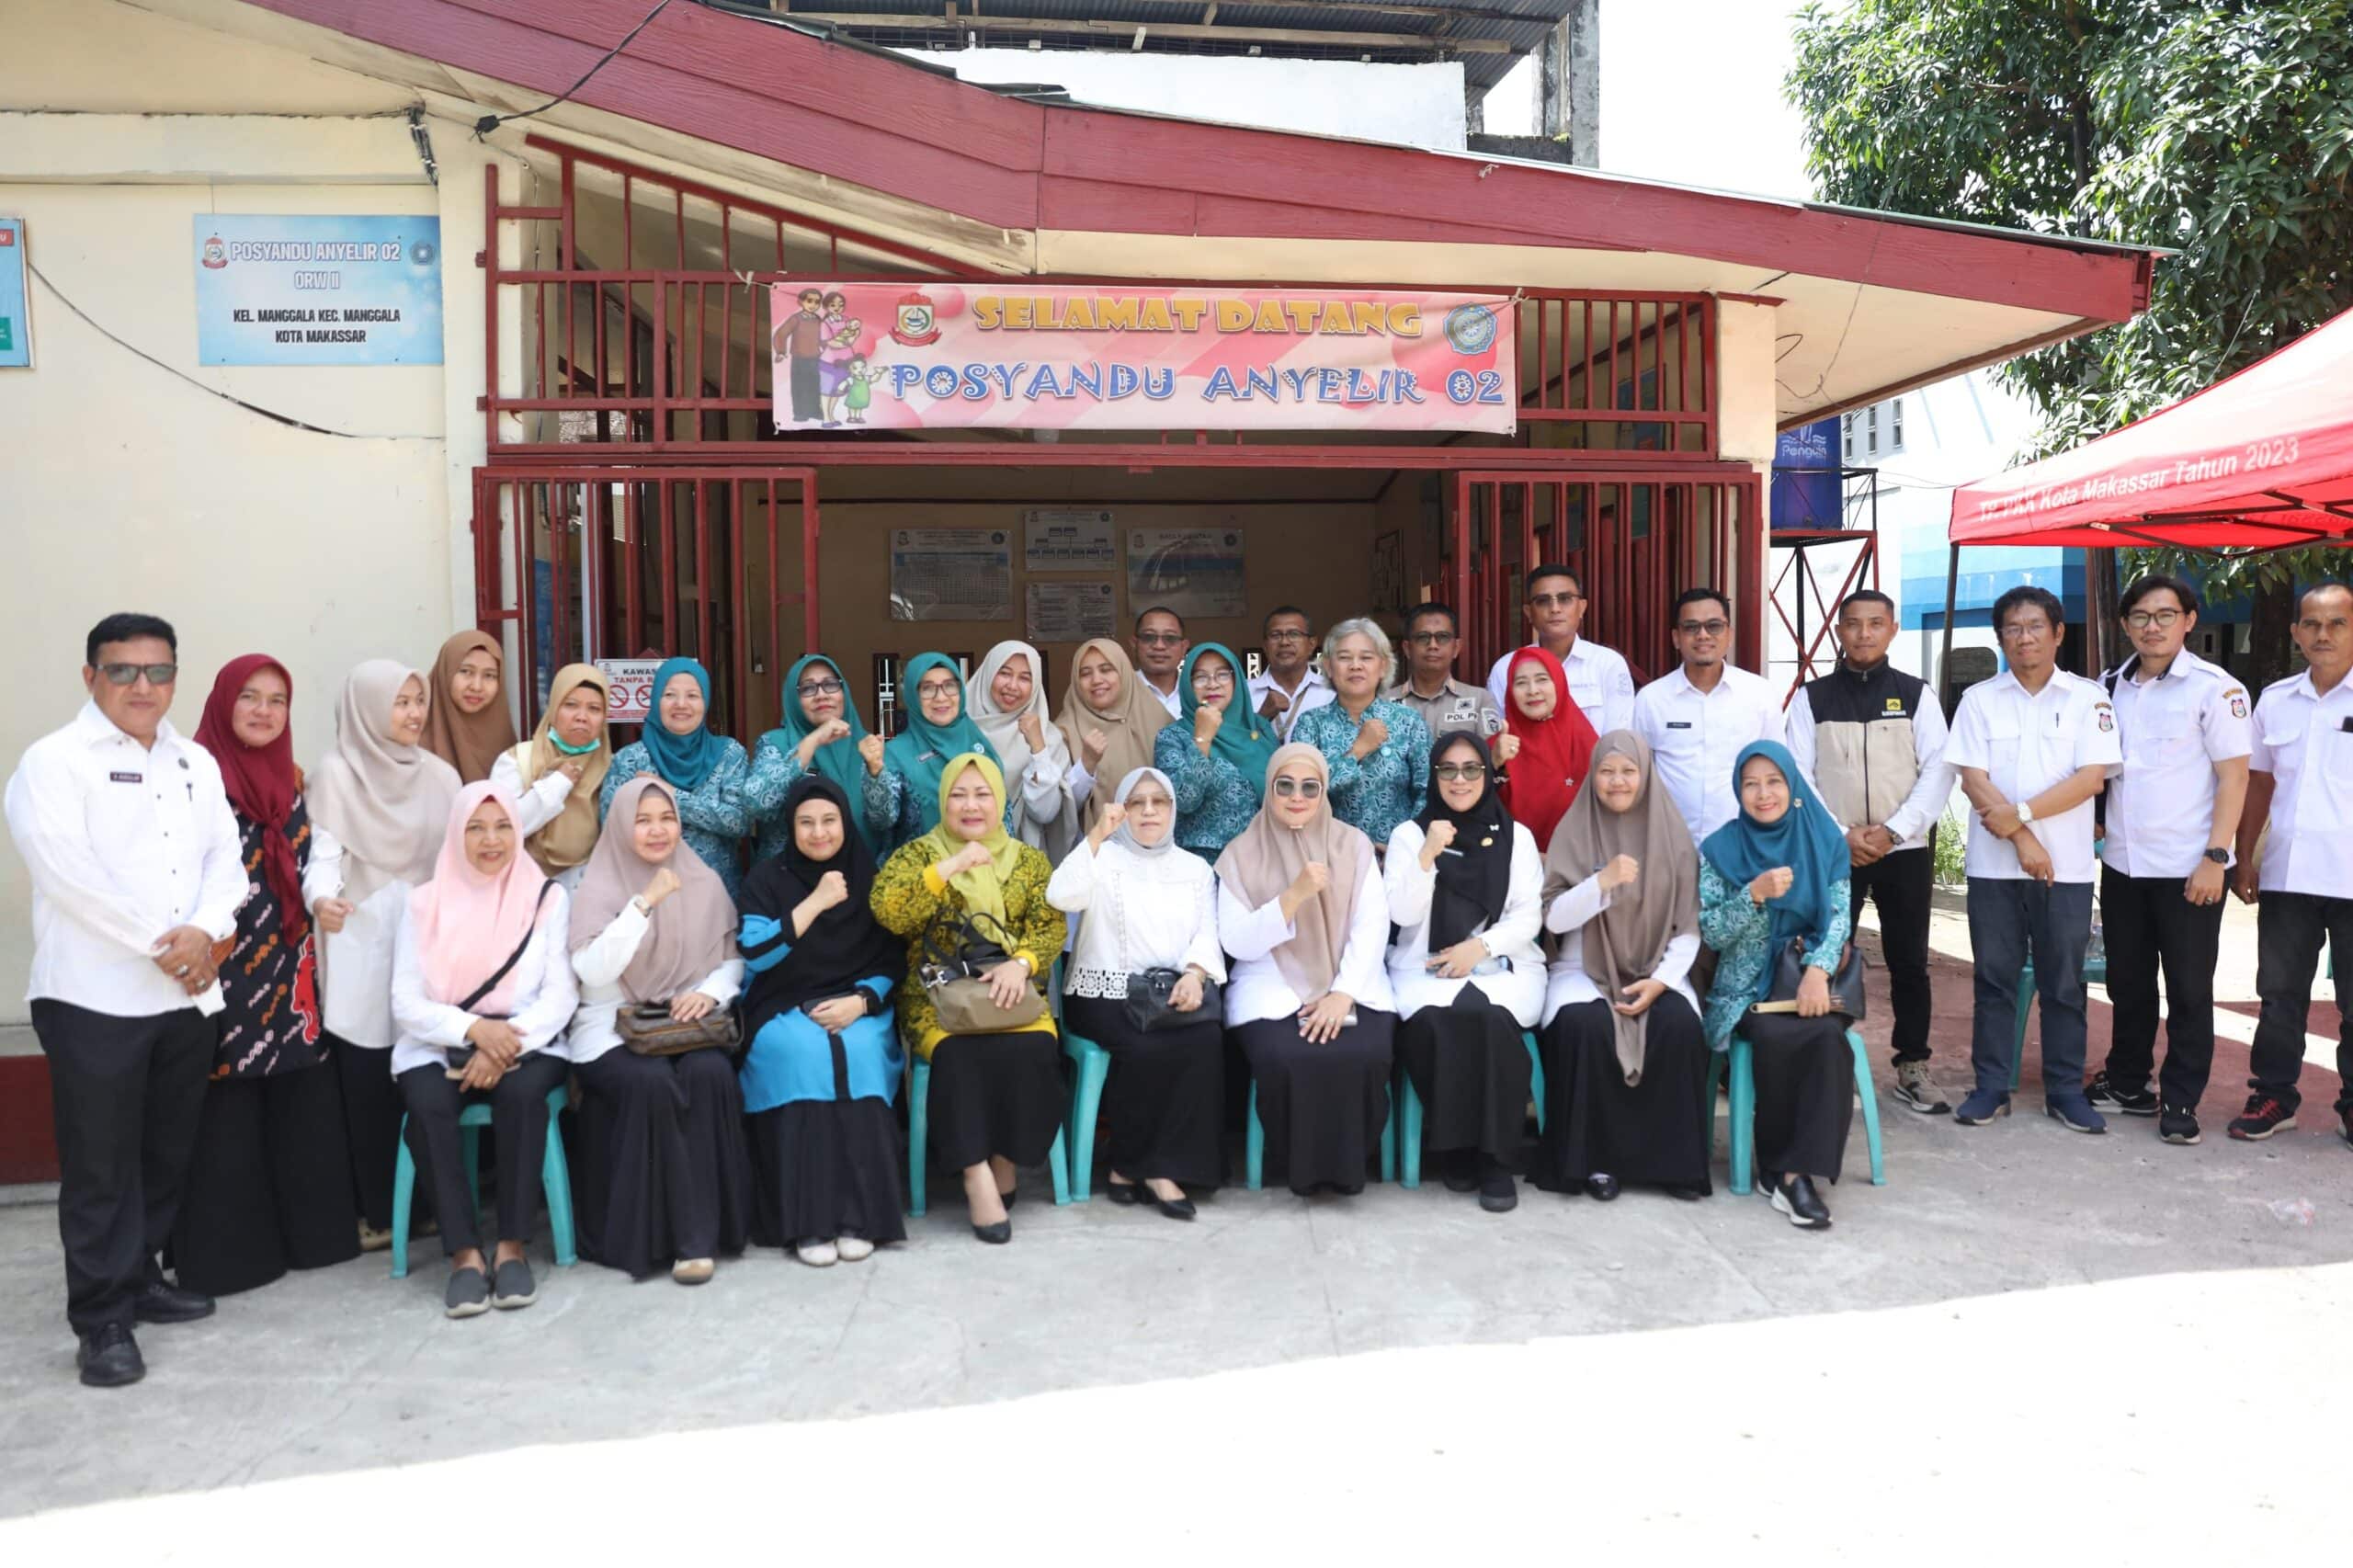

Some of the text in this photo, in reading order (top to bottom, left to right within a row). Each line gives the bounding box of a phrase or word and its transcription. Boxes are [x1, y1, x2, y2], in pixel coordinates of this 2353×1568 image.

[231, 241, 401, 262] POSYANDU ANYELIR 02
[294, 271, 329, 290] ORW
[233, 309, 401, 322] KEL. MANGGALA KEC. MANGGALA
[972, 294, 1423, 337] SELAMAT DATANG
[275, 329, 366, 343] KOTA MAKASSAR
[890, 361, 1505, 404] POSYANDU ANYELIR 02
[1781, 445, 1827, 458] Penguin
[2040, 488, 2078, 510] Kota
[2082, 470, 2169, 501] Makassar
[2175, 454, 2238, 484] Tahun
[2244, 436, 2299, 472] 2023
[1447, 713, 1464, 722] POL
